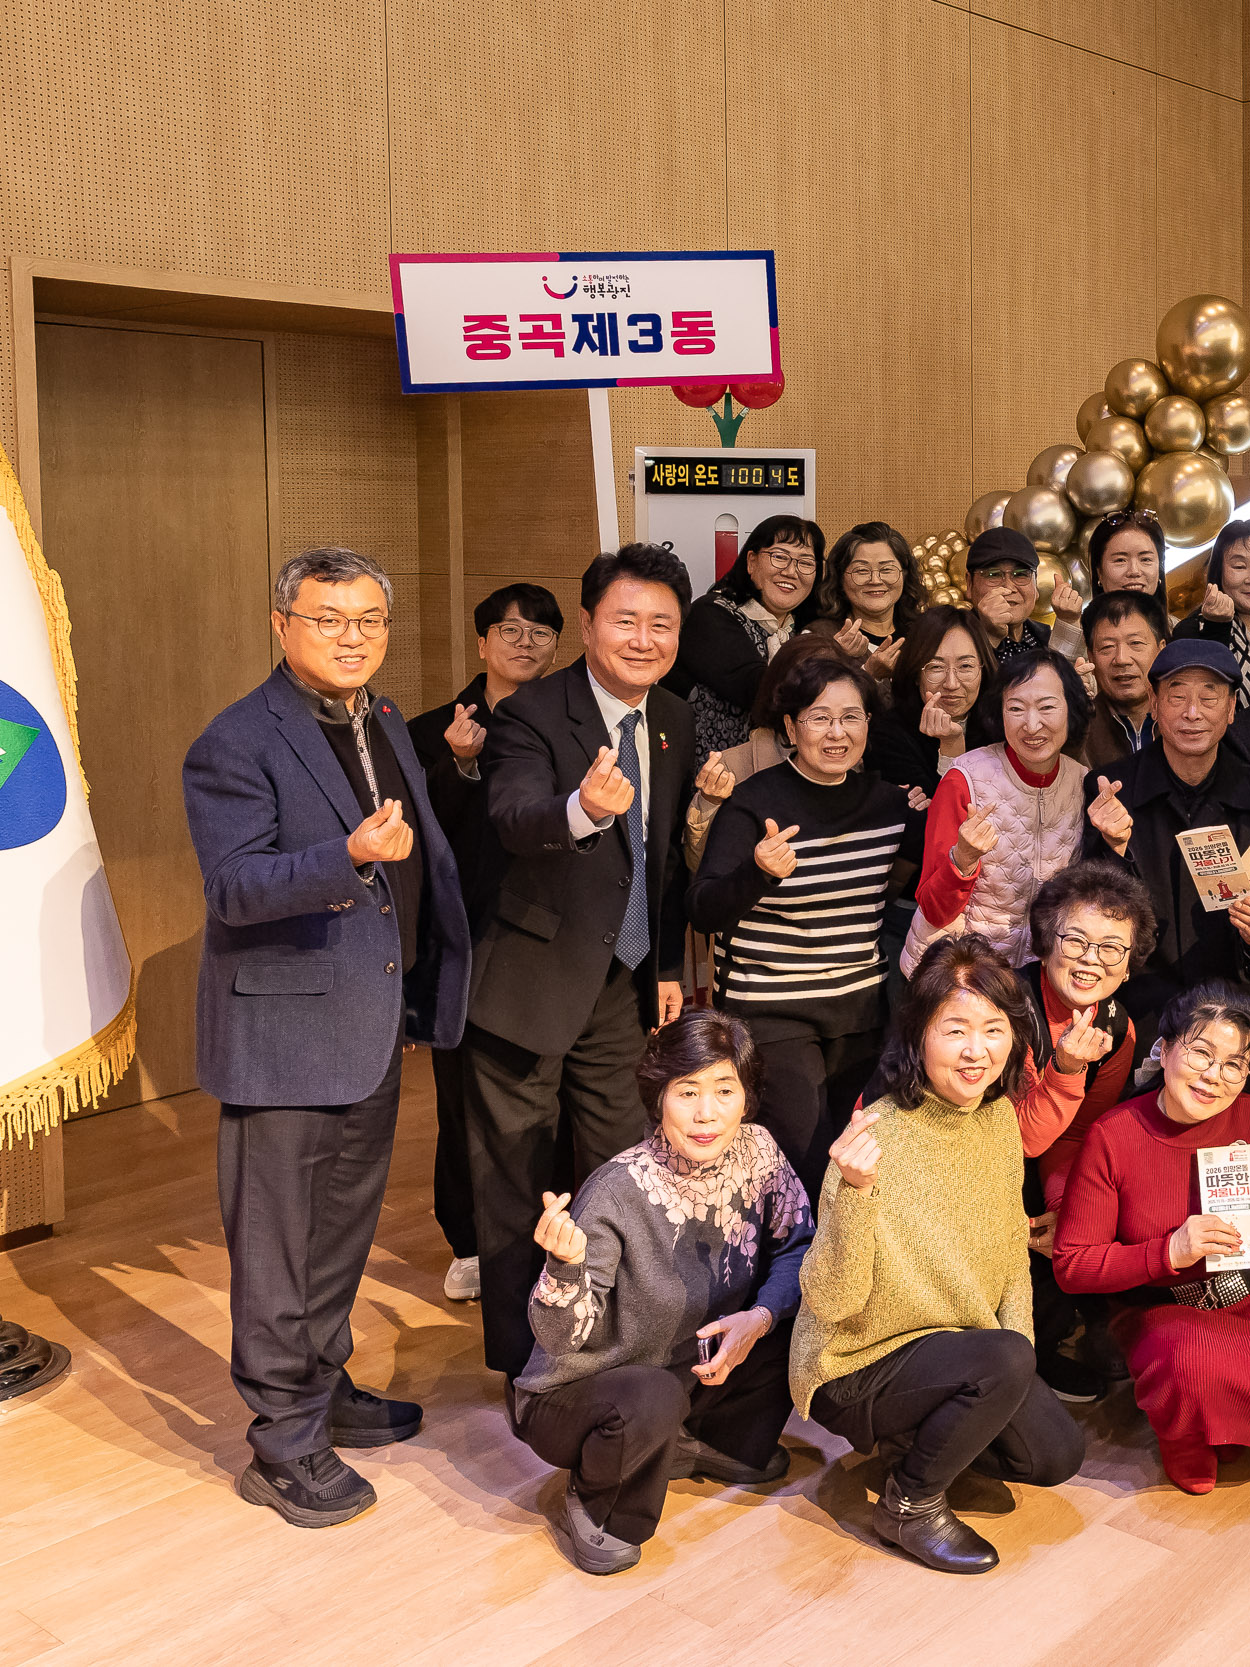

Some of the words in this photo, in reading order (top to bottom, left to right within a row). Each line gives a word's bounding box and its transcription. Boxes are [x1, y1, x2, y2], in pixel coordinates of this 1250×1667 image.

[582, 283, 631, 299] 행복광진
[462, 310, 716, 361] 중곡제3동
[652, 464, 689, 487] 사랑의
[694, 464, 719, 487] 온도
[730, 467, 782, 488] 100.4
[786, 467, 799, 486] 도
[1189, 847, 1231, 861] 따뜻한
[1192, 856, 1234, 867] 겨울나기
[1206, 1167, 1222, 1175] 2026
[1206, 1172, 1250, 1188] 따뜻한
[1207, 1186, 1250, 1199] 겨울나기
